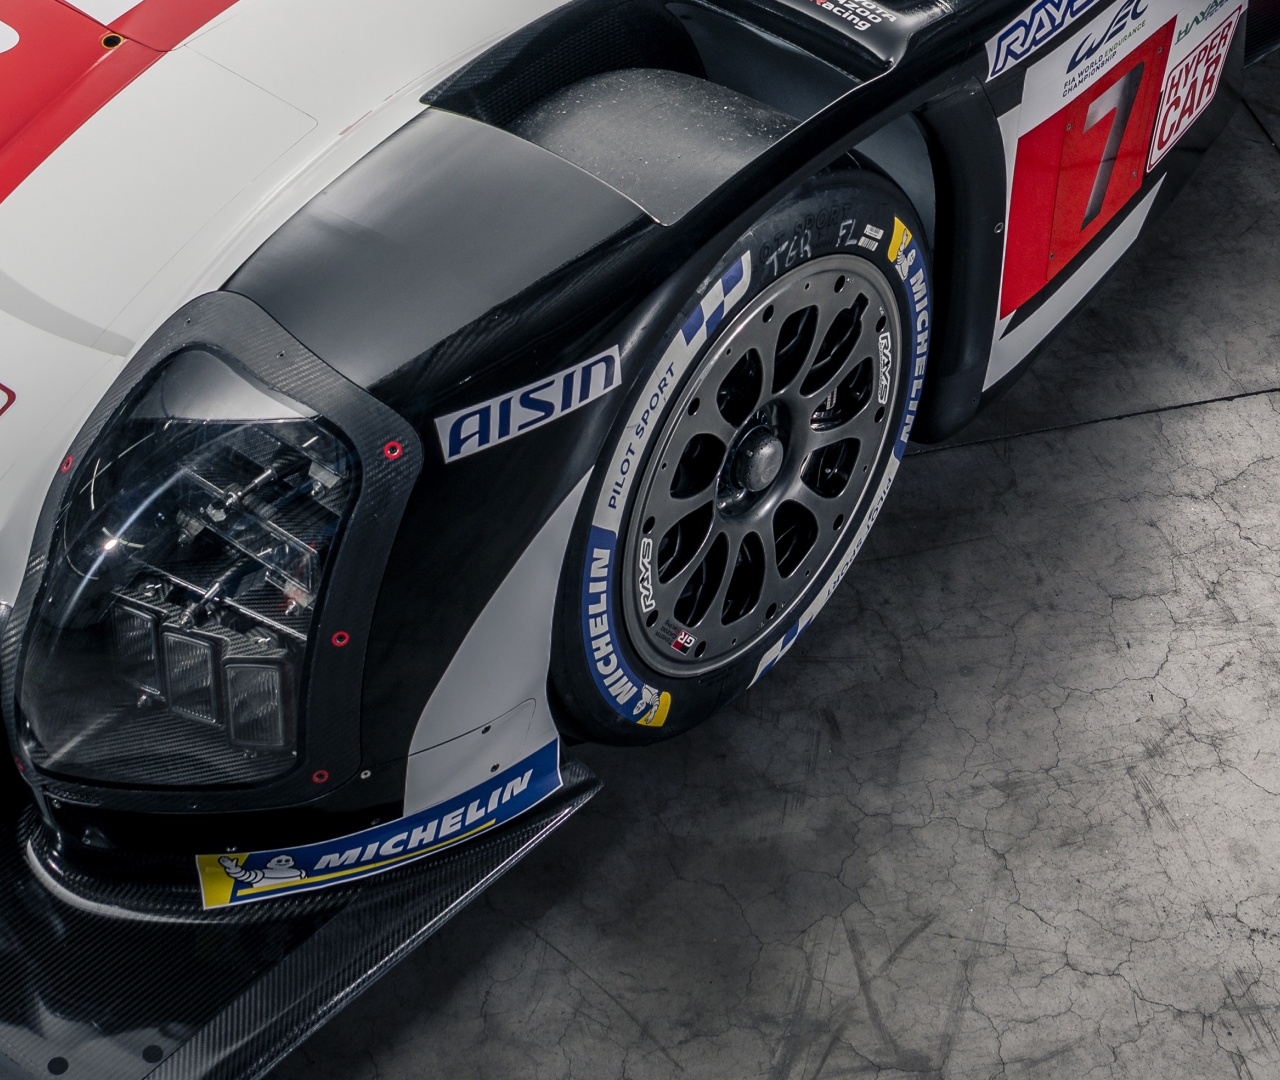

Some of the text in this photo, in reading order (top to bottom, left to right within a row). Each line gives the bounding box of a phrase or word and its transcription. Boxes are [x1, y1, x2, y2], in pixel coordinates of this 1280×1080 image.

[1062, 51, 1117, 98] CHAMPIONSHIP
[1064, 20, 1146, 89] FIA WORLD ENDURANCE
[1157, 53, 1221, 152] CAR
[1166, 21, 1232, 104] HYPER
[1079, 60, 1145, 233] 7
[448, 354, 616, 459] AISIN
[877, 331, 892, 405] RAYS
[900, 268, 931, 444] MICHELIN
[608, 362, 676, 510] PILOT SPORT
[639, 537, 656, 613] RAYS
[824, 477, 892, 602] PILOT SPORT
[588, 548, 639, 705] MICHELIN
[677, 630, 696, 648] GR
[314, 768, 533, 871] MICHELIN
